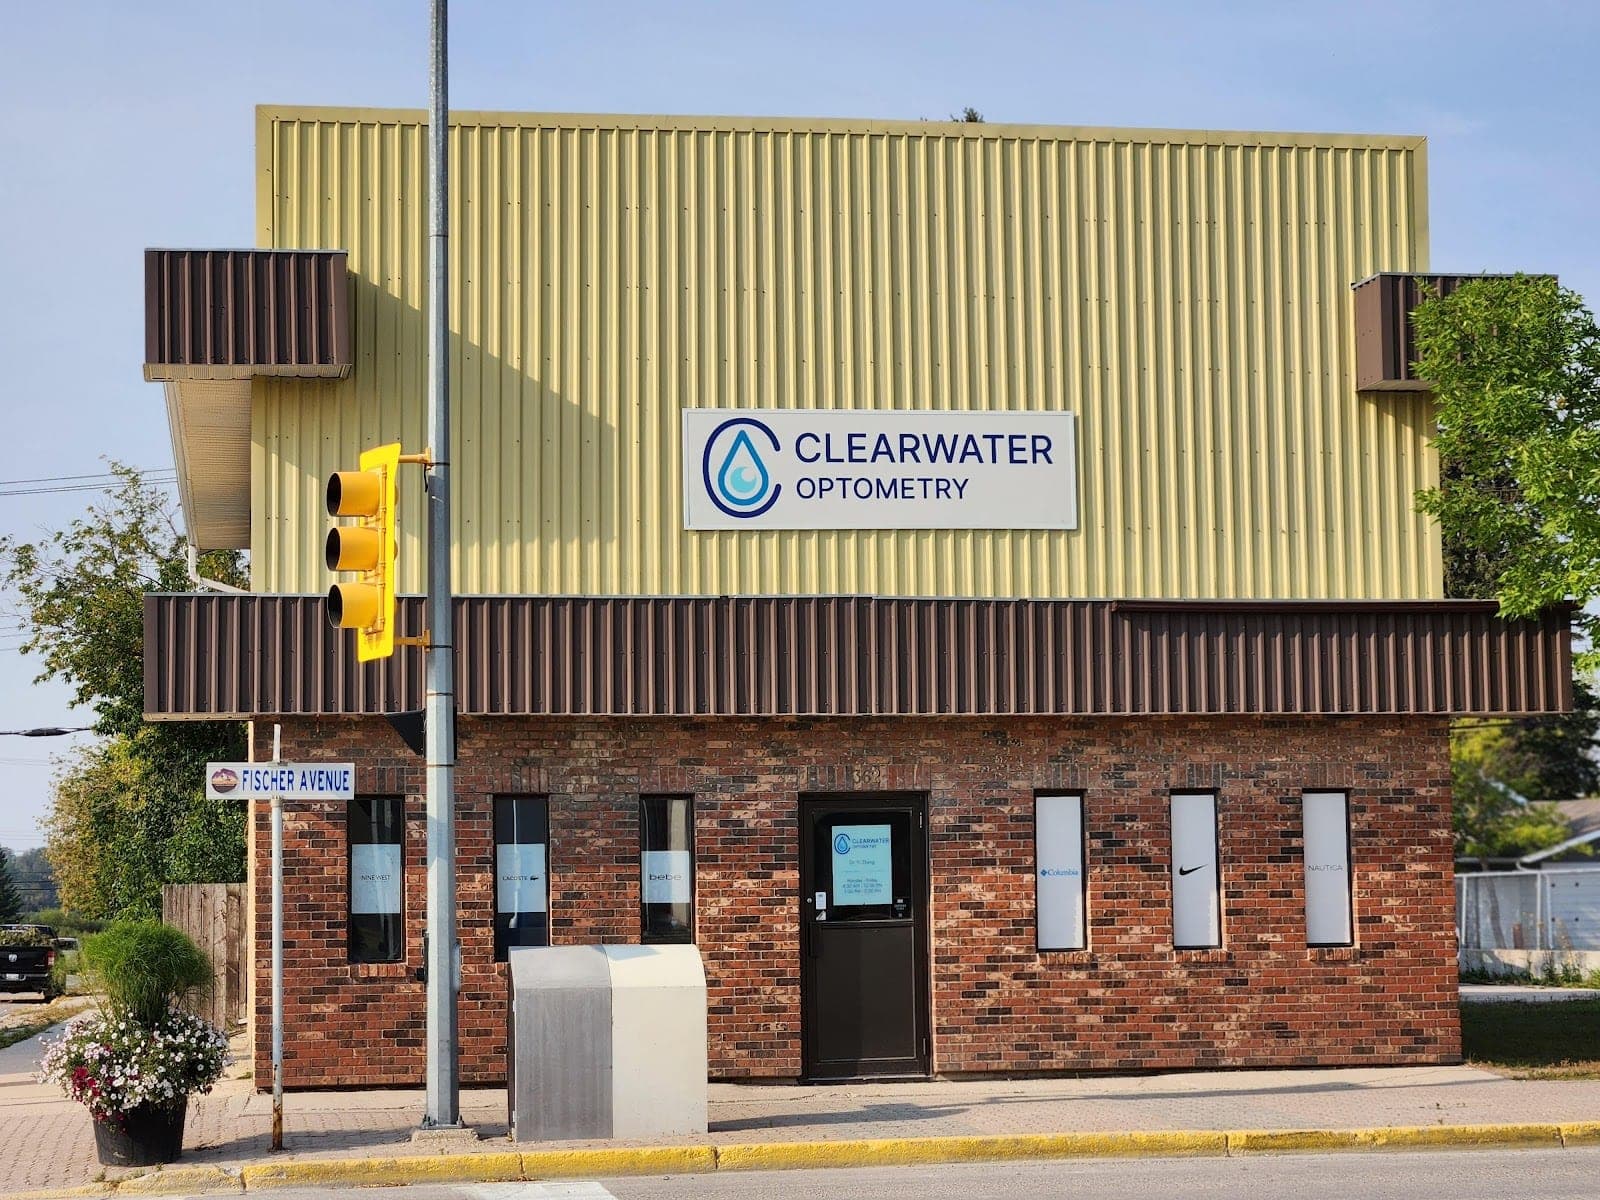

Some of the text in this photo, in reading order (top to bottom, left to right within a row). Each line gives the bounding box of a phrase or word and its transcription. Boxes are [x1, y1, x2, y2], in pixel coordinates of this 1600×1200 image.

[795, 432, 1054, 465] CLEARWATER
[796, 477, 969, 499] OPTOMETRY
[242, 770, 350, 792] FISCHER AVENUE
[649, 873, 682, 881] bebe
[1047, 868, 1079, 876] Columbia
